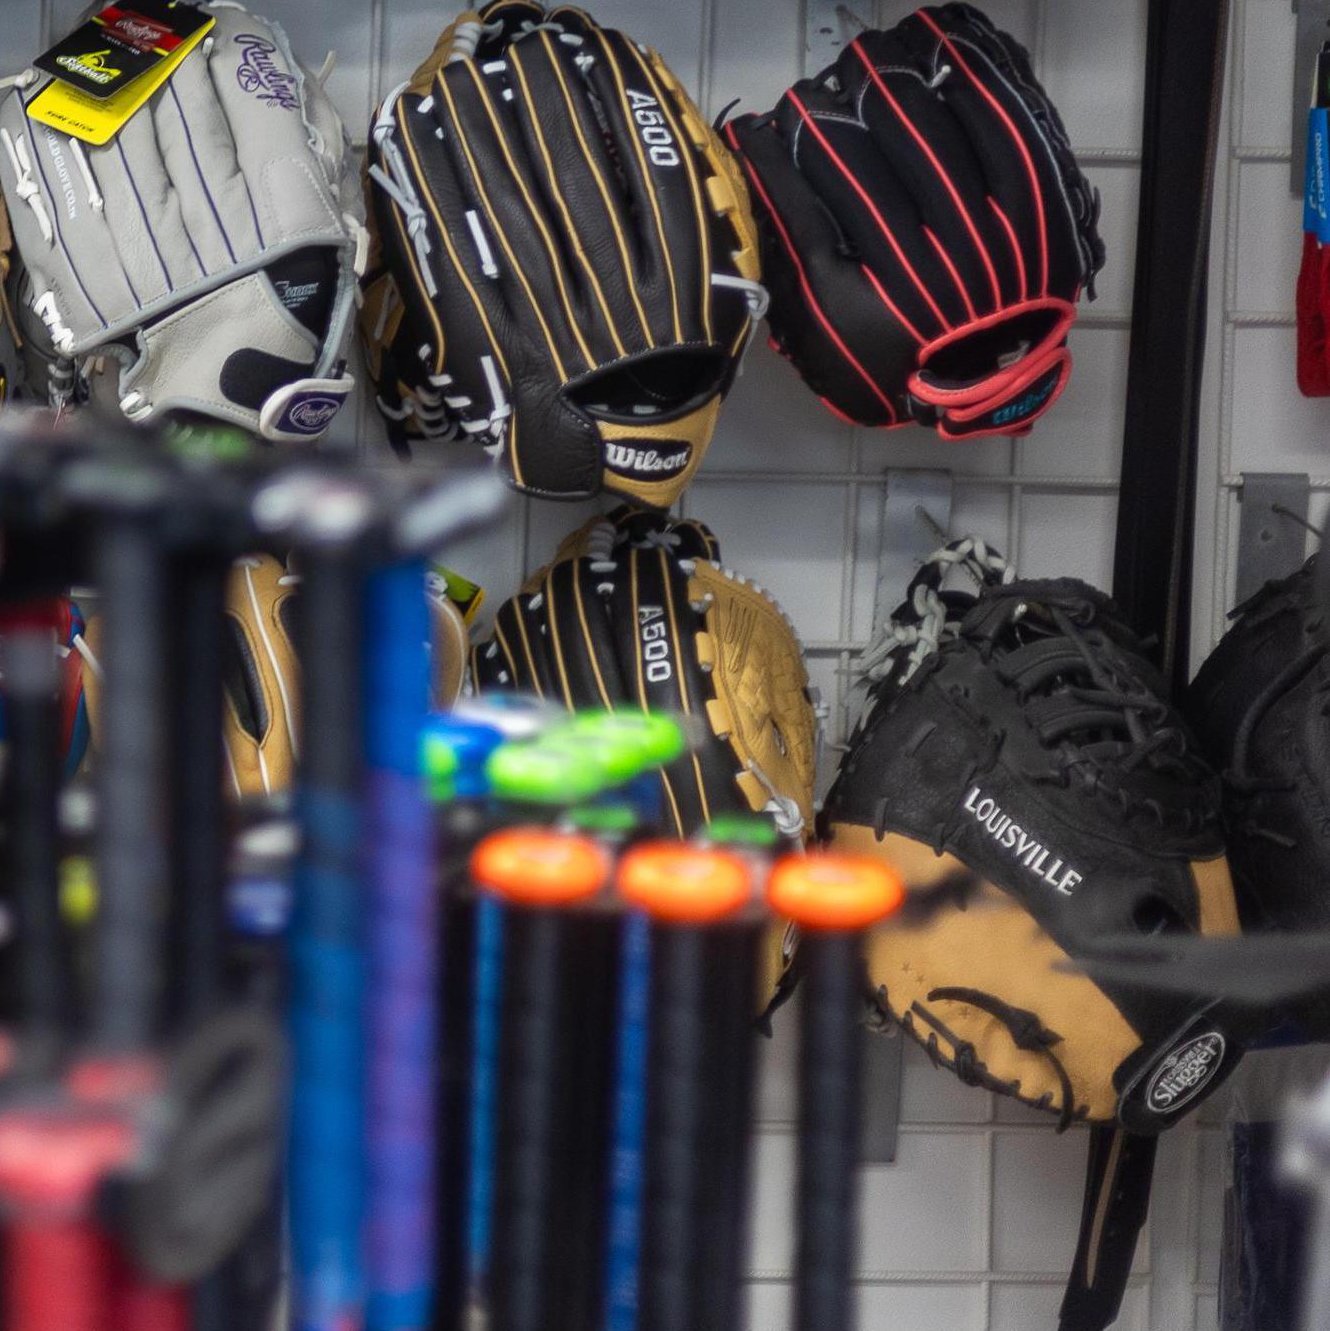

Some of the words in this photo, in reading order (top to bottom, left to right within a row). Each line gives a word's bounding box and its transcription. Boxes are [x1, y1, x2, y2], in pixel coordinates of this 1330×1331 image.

[234, 34, 301, 111] Rawlings
[626, 89, 680, 168] A500
[605, 443, 689, 472] Wilson
[636, 603, 672, 683] A500
[964, 786, 1083, 897] LOUISVILLE
[1154, 1044, 1219, 1107] Slugger
